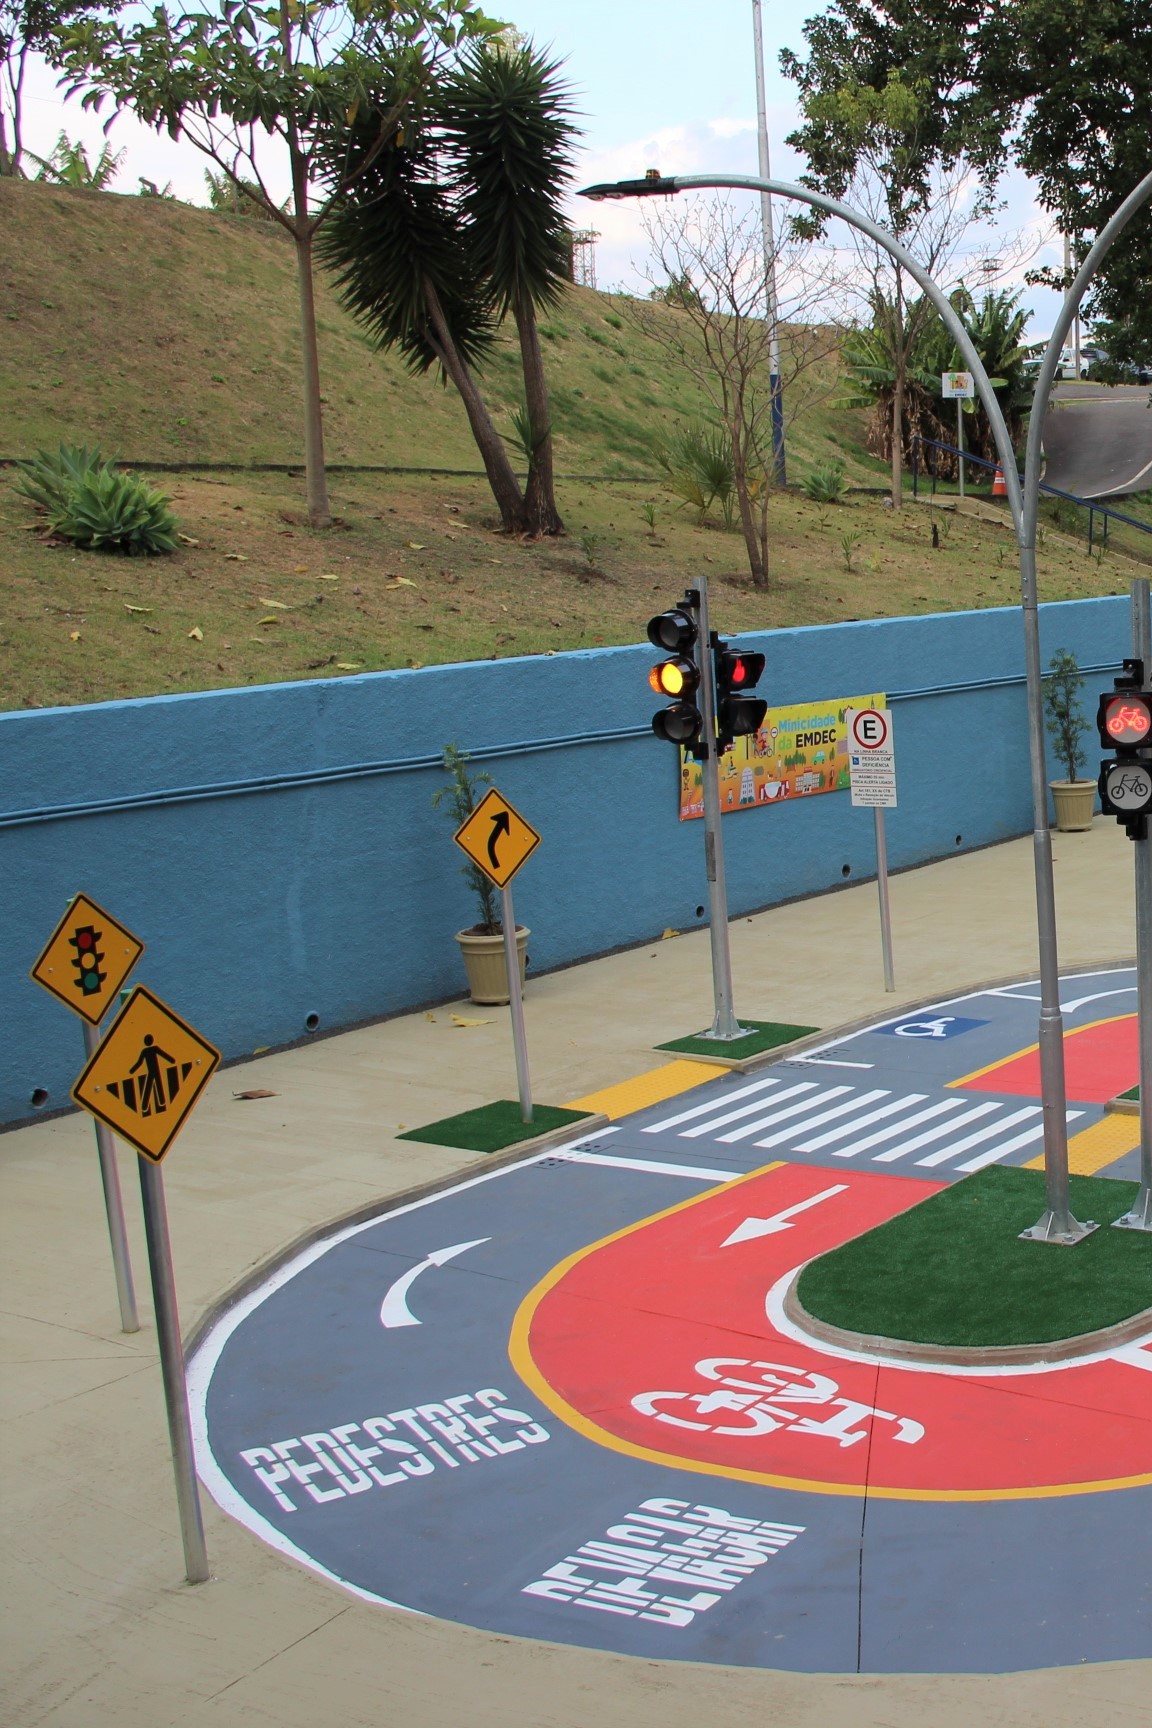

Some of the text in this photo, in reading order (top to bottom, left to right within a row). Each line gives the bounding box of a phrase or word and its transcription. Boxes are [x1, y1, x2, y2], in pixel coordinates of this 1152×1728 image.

[778, 714, 836, 733] Minicidade
[863, 719, 877, 739] E
[778, 728, 837, 751] da EMDEC
[239, 1388, 551, 1513] PEDESTRES
[520, 1497, 807, 1628] DEVAGAR
